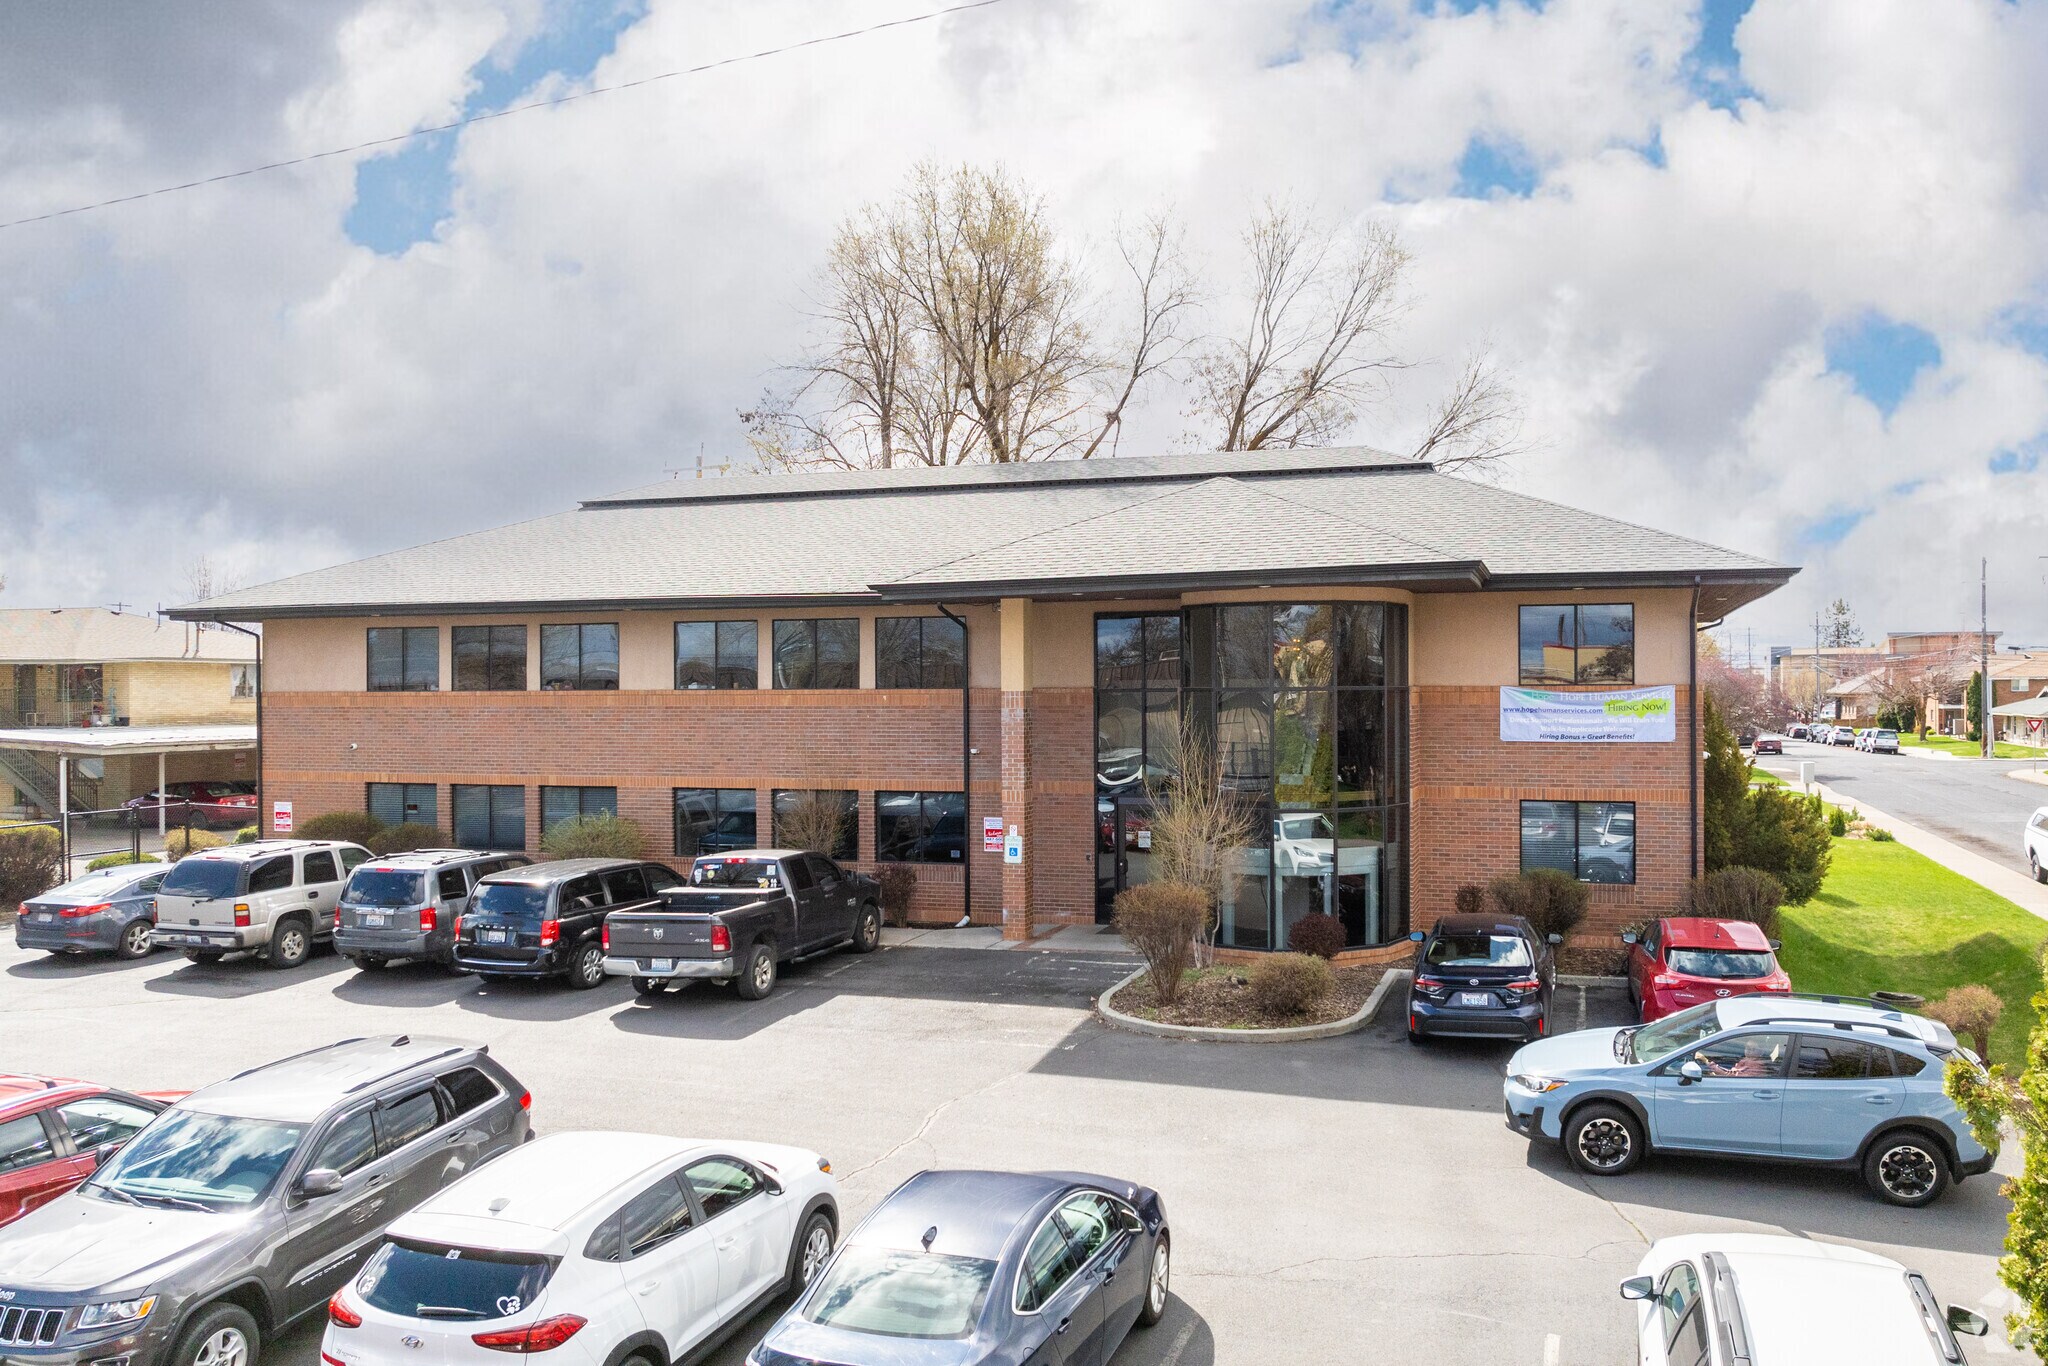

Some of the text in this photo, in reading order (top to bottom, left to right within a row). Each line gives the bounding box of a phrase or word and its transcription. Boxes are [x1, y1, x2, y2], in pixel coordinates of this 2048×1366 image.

[1589, 692, 1628, 701] HUMAN
[1503, 706, 1603, 714] www.hopehumanservices.com
[1608, 702, 1667, 712] HIRING NOW!
[0, 1287, 16, 1301] eep
